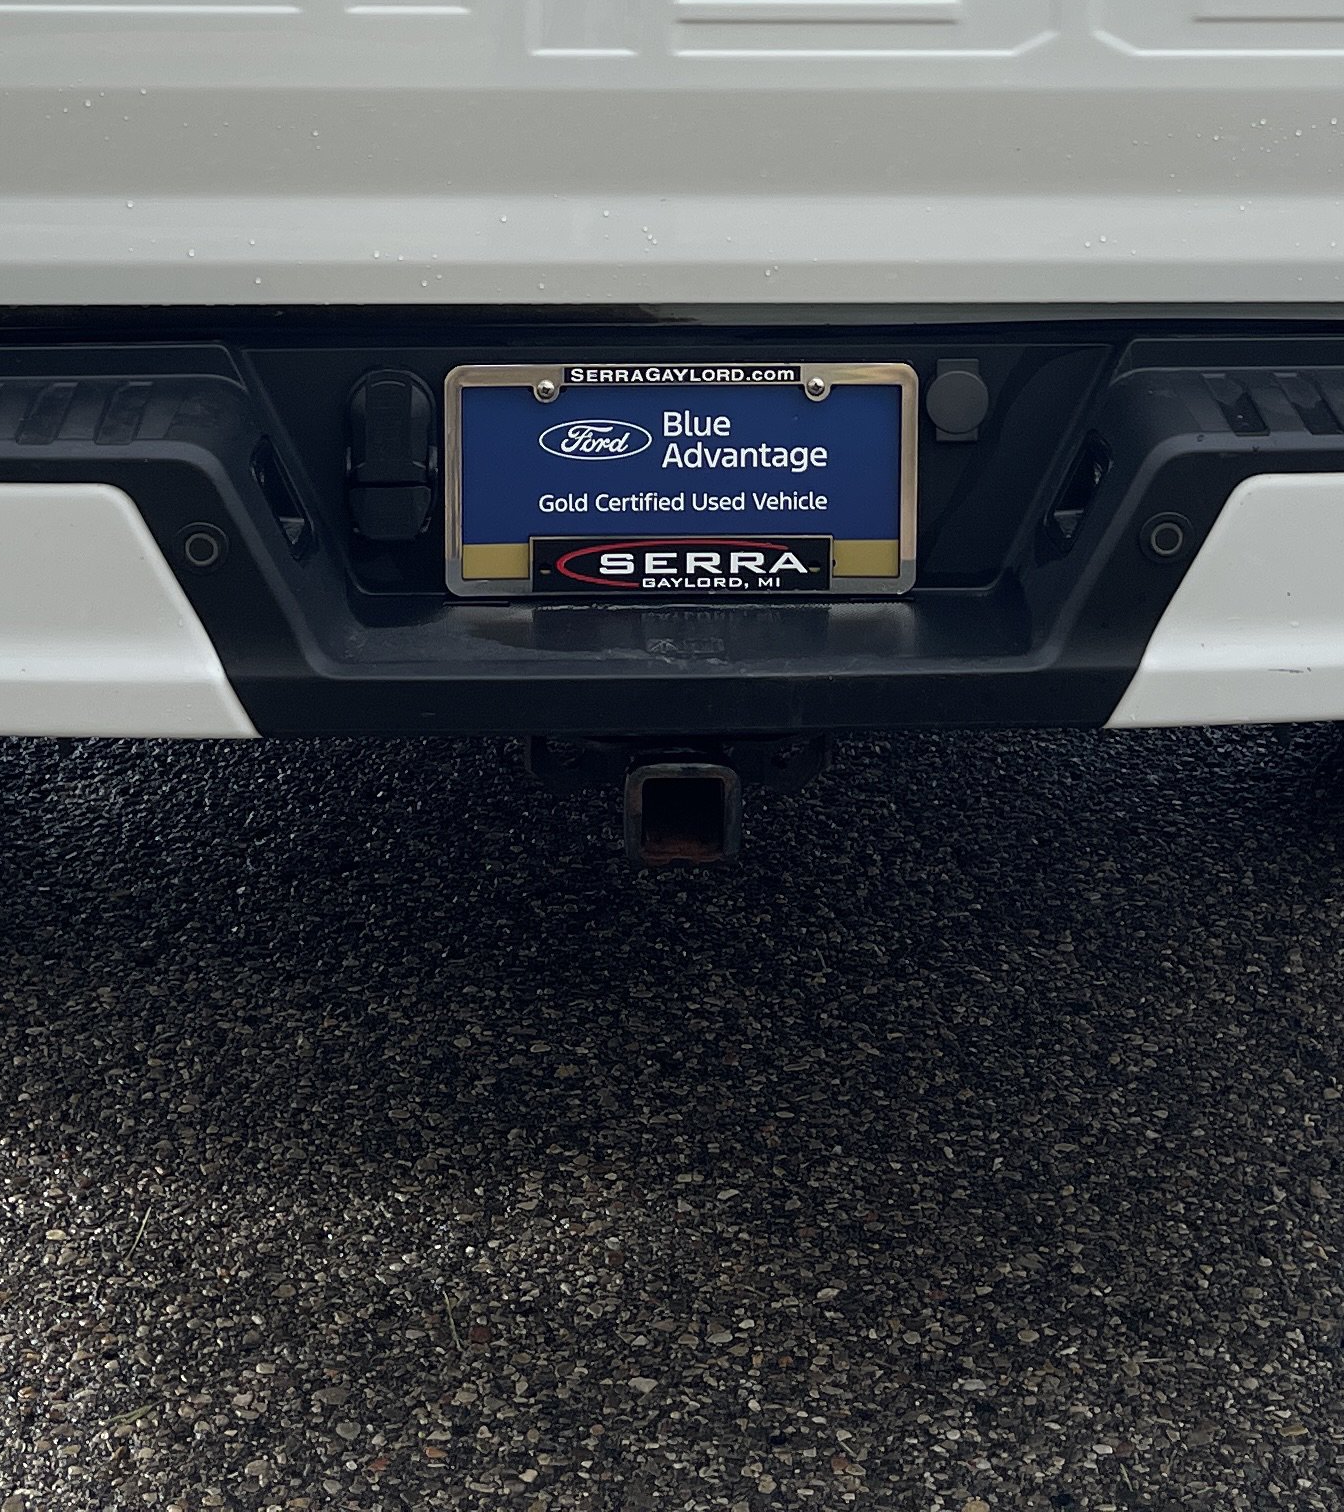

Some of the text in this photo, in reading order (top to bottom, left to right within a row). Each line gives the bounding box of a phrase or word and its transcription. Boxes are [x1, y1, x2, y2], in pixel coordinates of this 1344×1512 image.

[663, 410, 731, 437] Blue
[560, 425, 629, 454] Ford
[661, 441, 828, 473] Advantage
[538, 490, 828, 513] Gold Certified Used Vehicle
[599, 551, 809, 574] SERRA
[642, 577, 781, 590] GAYLORD, MI
